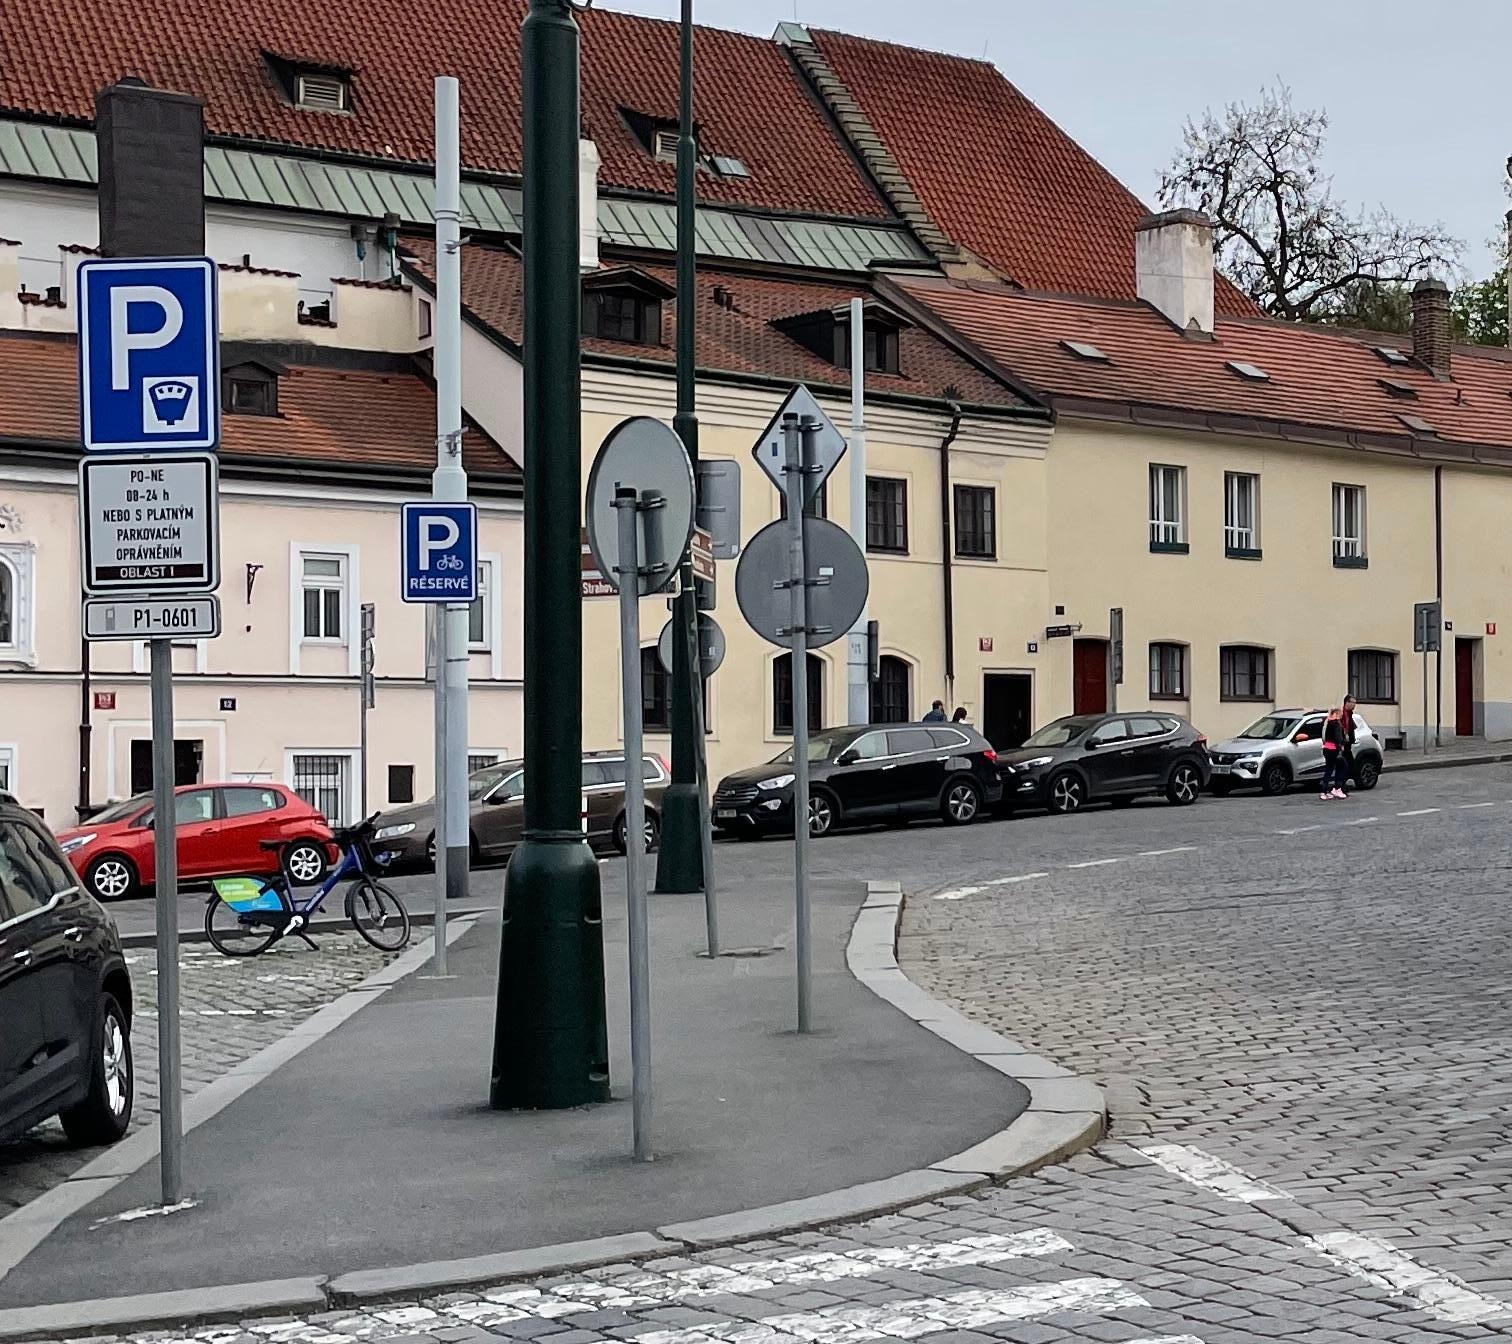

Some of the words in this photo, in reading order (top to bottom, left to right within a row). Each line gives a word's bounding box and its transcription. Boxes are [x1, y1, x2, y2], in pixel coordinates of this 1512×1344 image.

[110, 285, 183, 390] P
[130, 469, 164, 483] PO-NE
[126, 489, 158, 502] 08-24
[162, 489, 169, 501] h
[103, 509, 131, 522] NEBO
[135, 509, 142, 522] S
[147, 504, 193, 521] PLATNÝM
[116, 524, 181, 541] PARKOVACÍM
[419, 515, 459, 570] P
[116, 544, 182, 561] OPRÁVNĚNÍM
[120, 566, 167, 578] OBLAST
[410, 574, 469, 589] RÉSERVÉ
[133, 607, 197, 628] P1-0601
